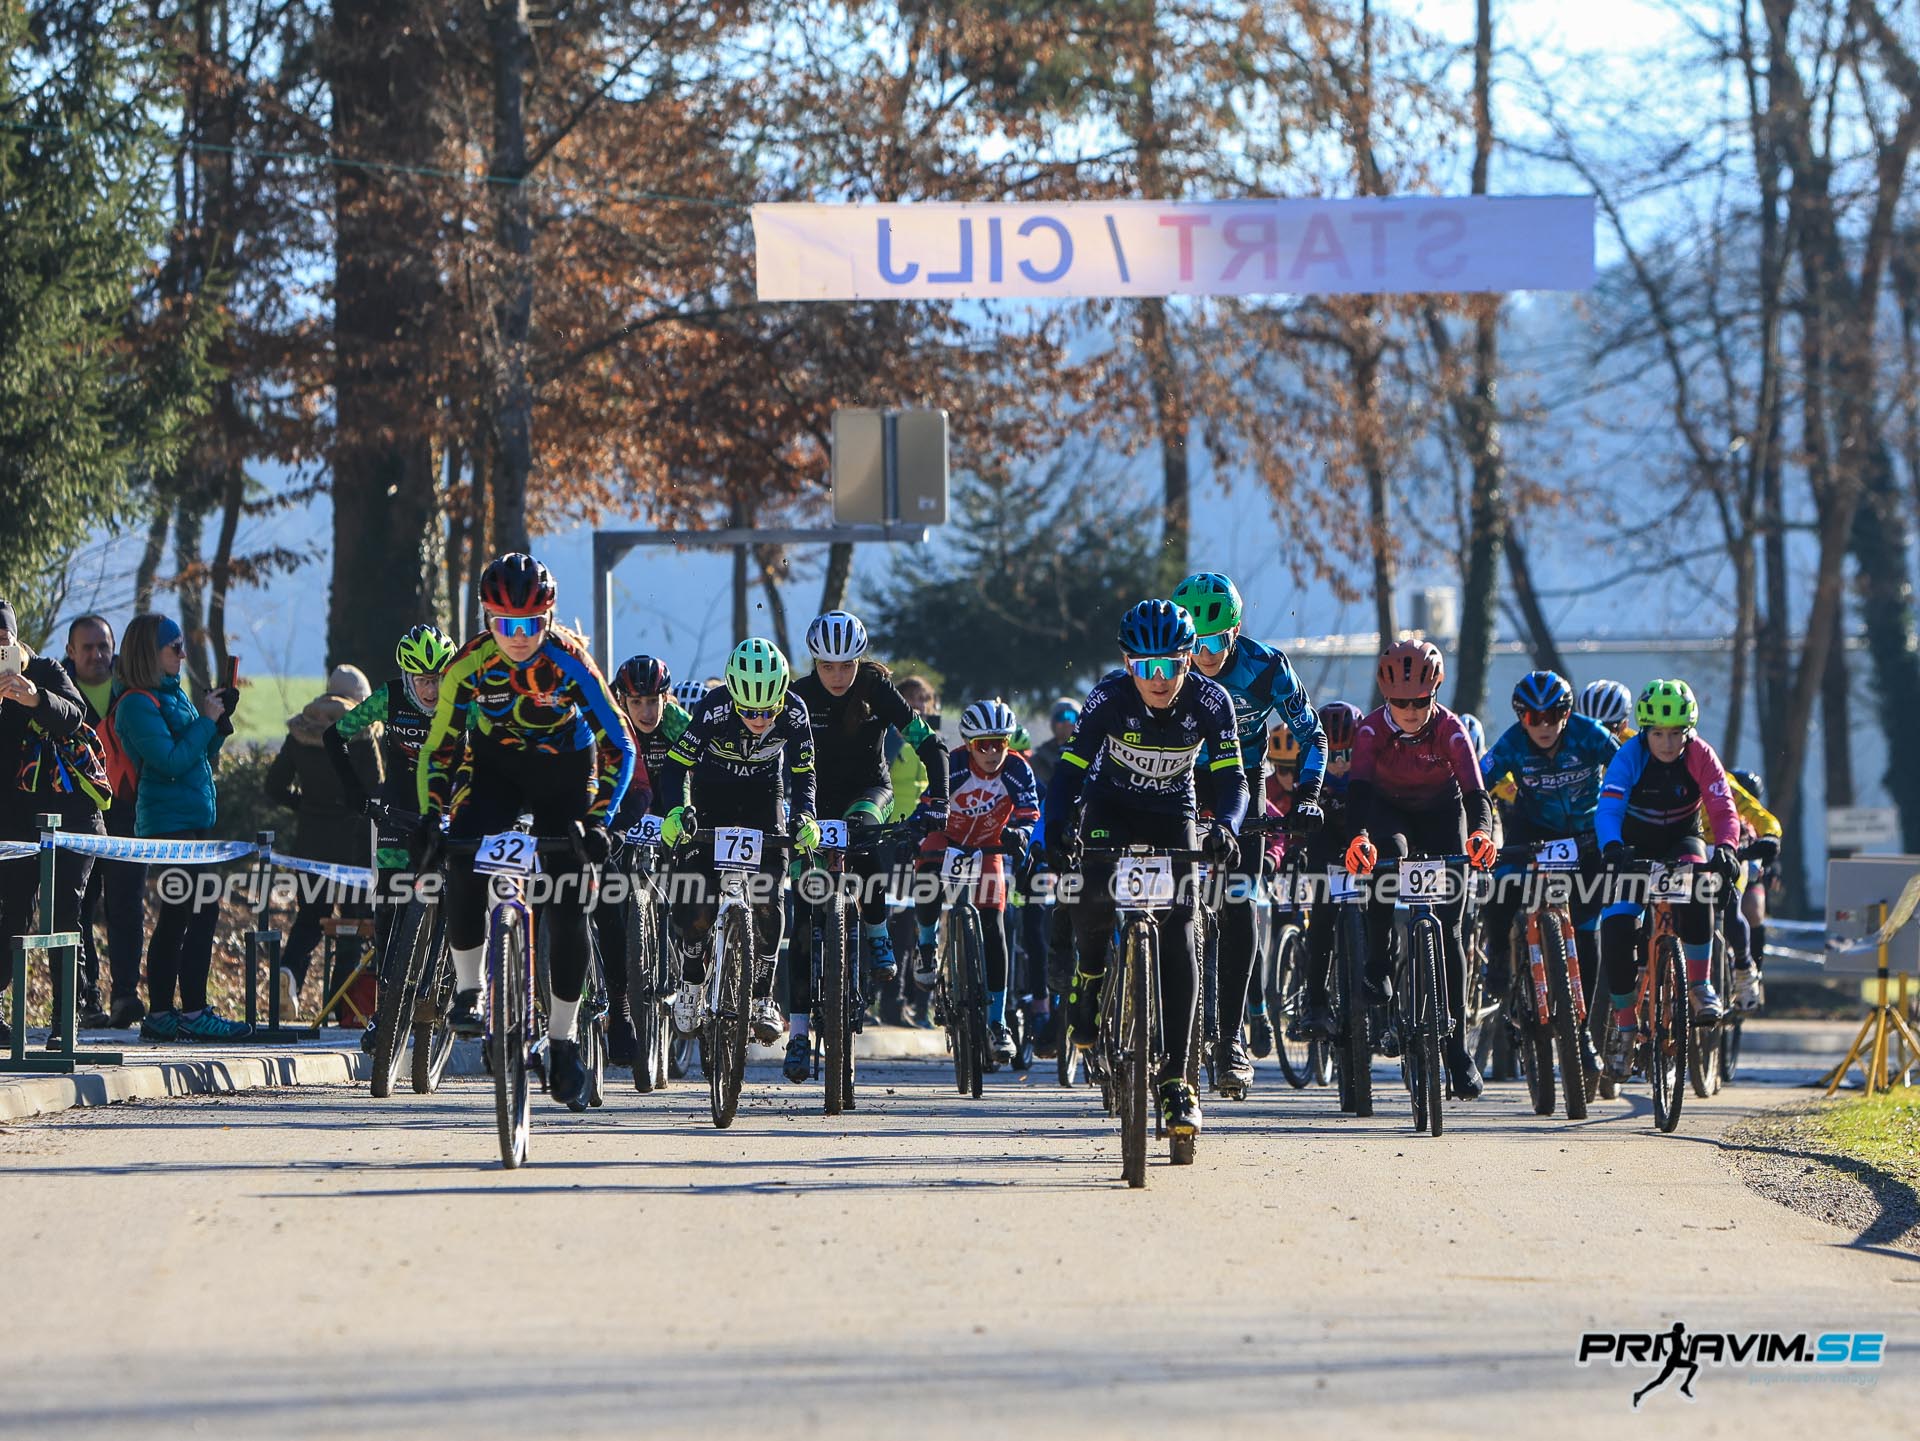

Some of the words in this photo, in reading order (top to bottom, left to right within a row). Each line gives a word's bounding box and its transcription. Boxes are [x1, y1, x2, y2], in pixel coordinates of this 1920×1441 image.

[1085, 691, 1108, 714] LOVE
[1200, 694, 1220, 715] LOVE
[1206, 687, 1226, 705] FEEL
[1111, 741, 1156, 773] POGI
[1130, 773, 1172, 791] UAE
[630, 820, 655, 837] 96
[489, 838, 525, 864] 32
[725, 836, 754, 862] 75
[951, 854, 975, 876] 81
[1128, 866, 1160, 897] 67
[1410, 869, 1437, 895] 92
